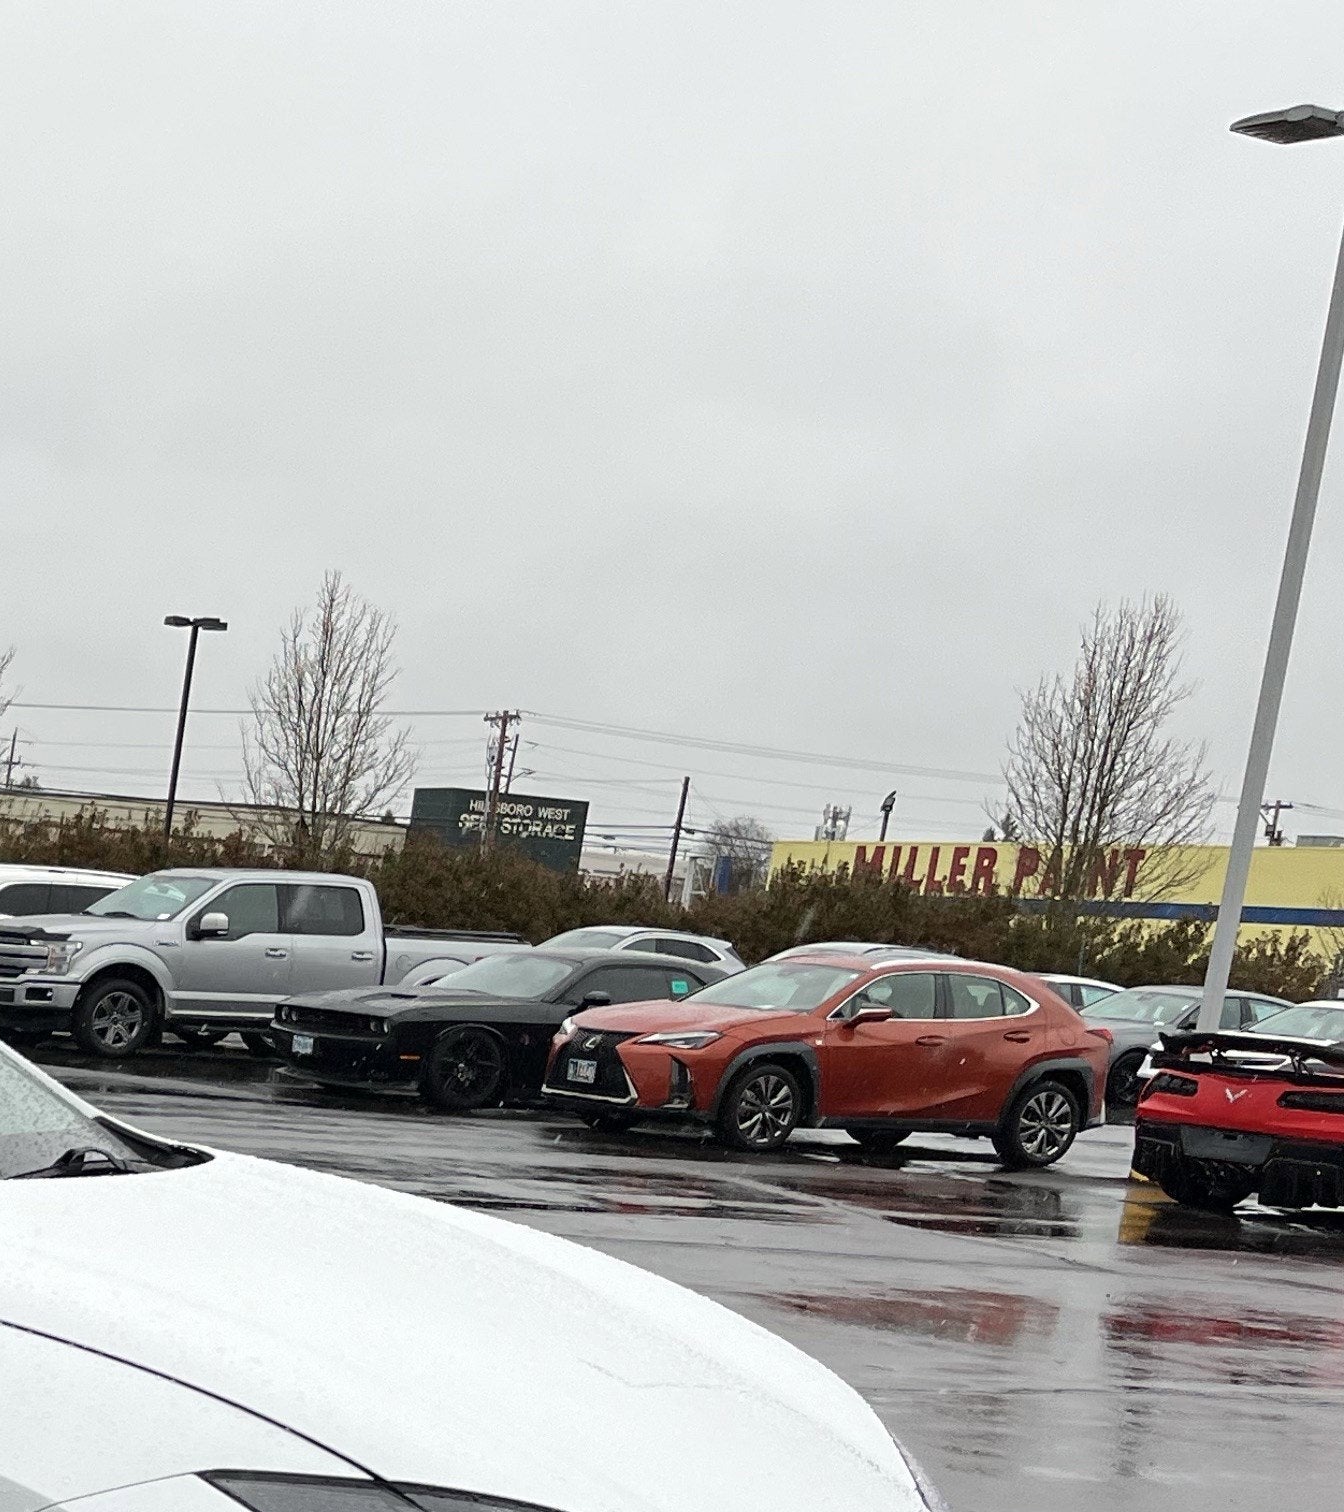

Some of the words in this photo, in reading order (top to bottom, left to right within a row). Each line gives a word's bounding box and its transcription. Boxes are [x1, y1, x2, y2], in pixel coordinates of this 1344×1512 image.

[537, 806, 571, 821] WEST
[500, 817, 577, 841] STORAGE
[850, 845, 999, 897] MILLER
